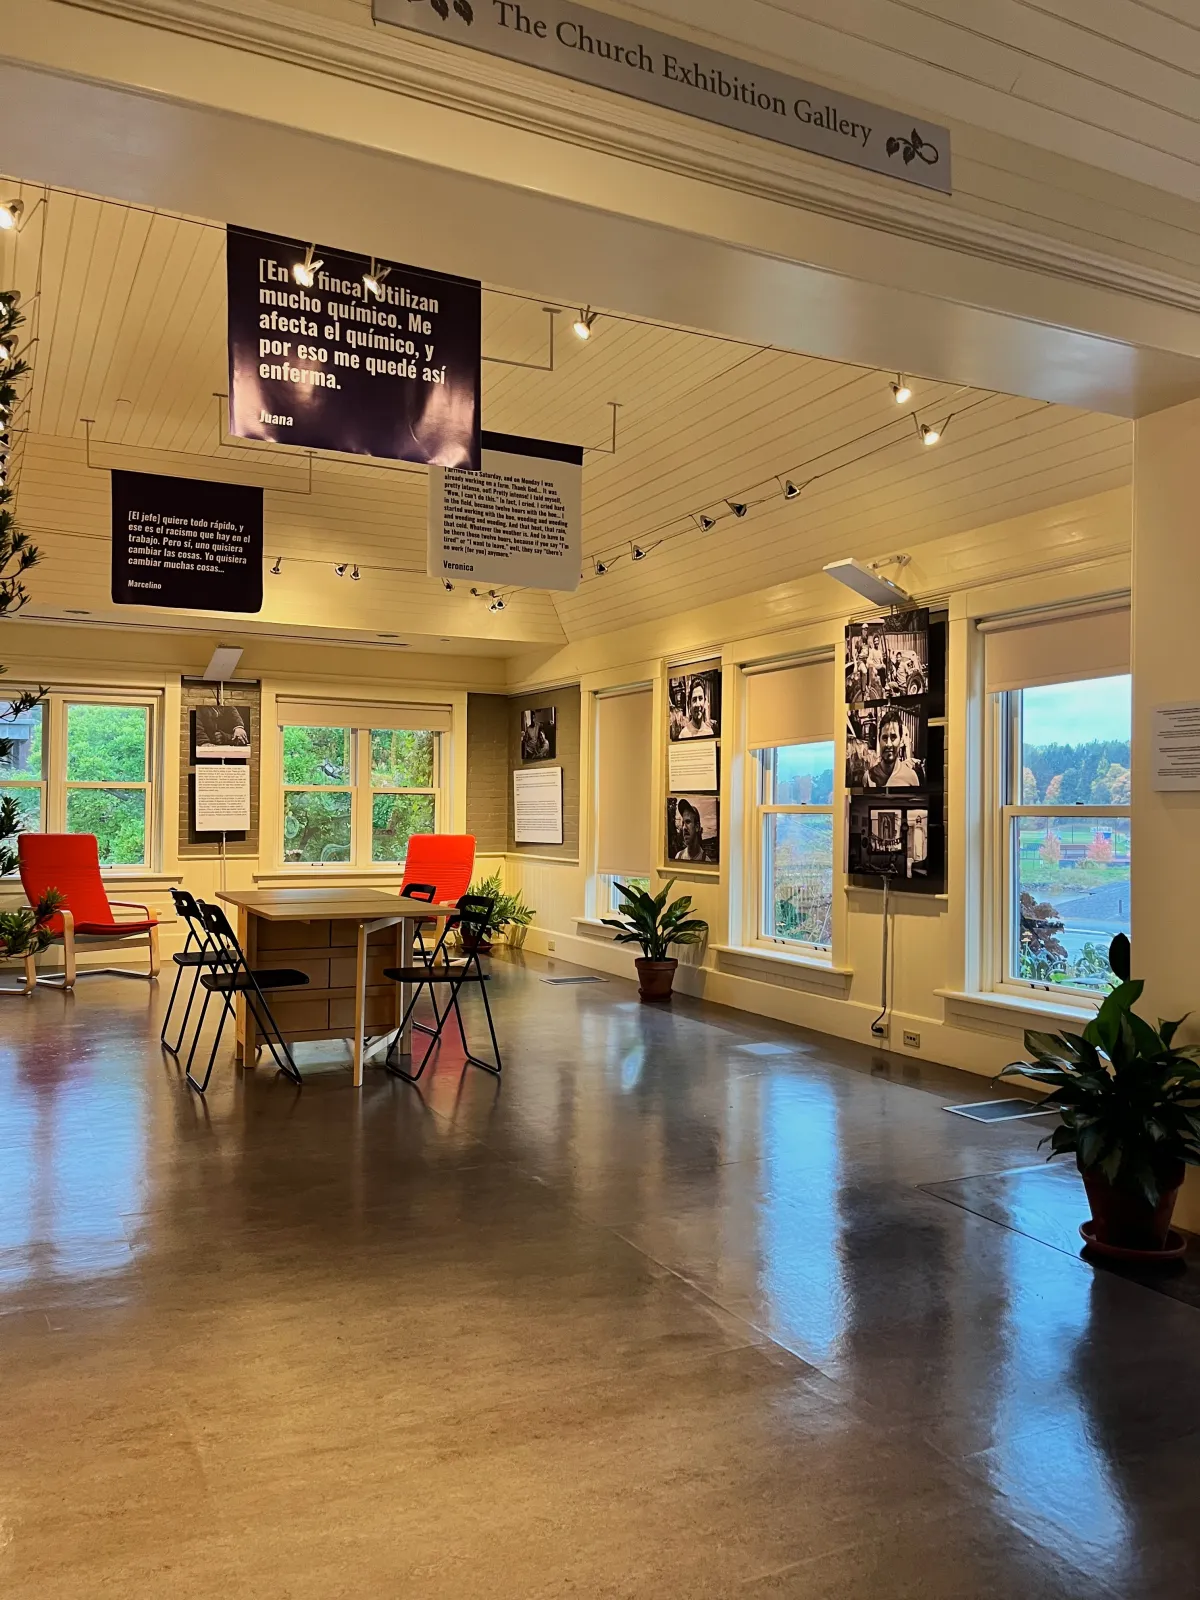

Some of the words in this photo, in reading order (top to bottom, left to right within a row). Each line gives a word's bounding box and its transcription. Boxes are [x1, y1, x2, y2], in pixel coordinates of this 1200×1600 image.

[493, 0, 547, 38] The
[555, 21, 655, 74] Church
[662, 53, 787, 117] Exhibition
[793, 99, 873, 148] Gallery
[259, 258, 289, 283] [En
[317, 270, 369, 303] finca]
[374, 283, 439, 314] Utilizan
[259, 288, 322, 313] mucho
[327, 301, 402, 329] químico.
[408, 312, 432, 335] Me
[259, 311, 318, 338] afecta
[324, 321, 340, 342] el
[346, 328, 419, 359] químico,
[424, 343, 434, 361] y
[259, 338, 291, 358] por
[297, 343, 328, 363] eso
[334, 350, 360, 369] me
[365, 357, 417, 380] quedé
[422, 365, 447, 385] así
[259, 362, 342, 390] enferma.
[259, 409, 294, 427] Juana
[479, 472, 502, 481] Saturday,
[128, 510, 140, 521] [El
[141, 512, 160, 525] jefe]
[162, 515, 189, 526] quiere
[190, 518, 208, 528] todo
[210, 520, 238, 532] rápido,
[239, 524, 244, 533] y
[128, 524, 143, 532] ese
[156, 525, 164, 535] el
[165, 528, 198, 538] racismo
[199, 531, 215, 540] que
[216, 531, 230, 543] hay
[232, 534, 242, 542] en
[243, 534, 251, 544] el
[128, 533, 160, 546] trabajo.
[162, 536, 182, 547] Pero
[183, 539, 193, 549] sí,
[195, 541, 210, 550] uno
[211, 542, 243, 553] quisiera
[128, 546, 162, 556] cambiar
[163, 548, 176, 558] las
[177, 551, 202, 560] cosas.
[204, 551, 214, 561] Yo
[215, 553, 247, 564] quisiera
[128, 557, 162, 567] cambiar
[163, 560, 195, 571] muchas
[443, 560, 474, 571] Veronica
[127, 579, 162, 590] Marcelino
